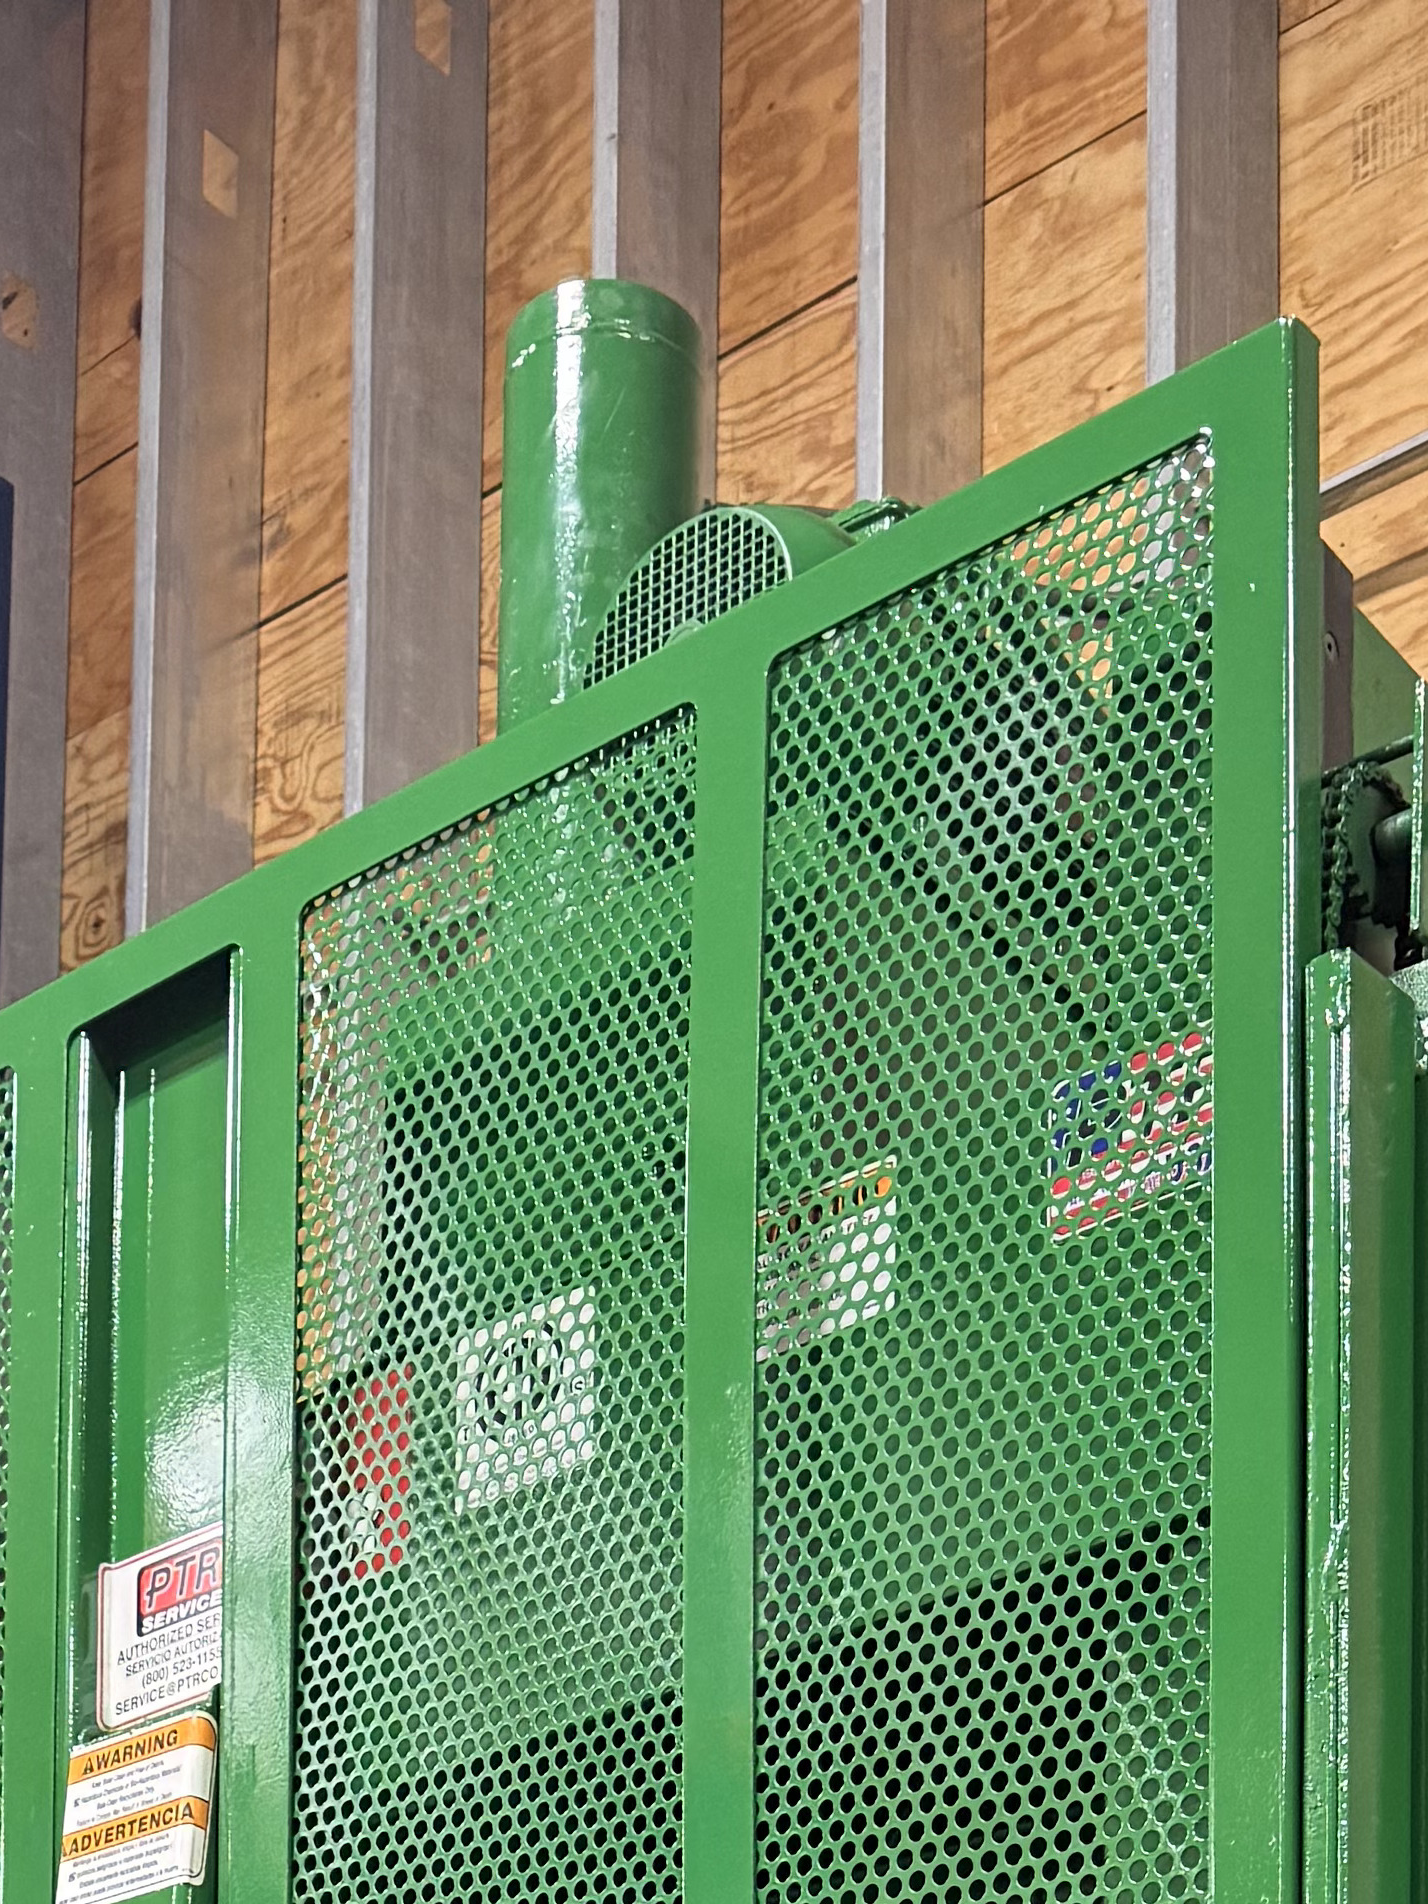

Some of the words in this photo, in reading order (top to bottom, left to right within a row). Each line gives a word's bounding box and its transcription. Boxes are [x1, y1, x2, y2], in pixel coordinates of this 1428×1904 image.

[145, 1545, 221, 1610] PTR
[141, 1588, 222, 1634] SERVICE
[117, 1622, 193, 1666] AUTHORIZED
[125, 1650, 171, 1678] SERVICIO
[141, 1666, 169, 1689] (800)
[95, 1729, 179, 1771] WARNING
[69, 1803, 195, 1856] ADVERTENCIA
